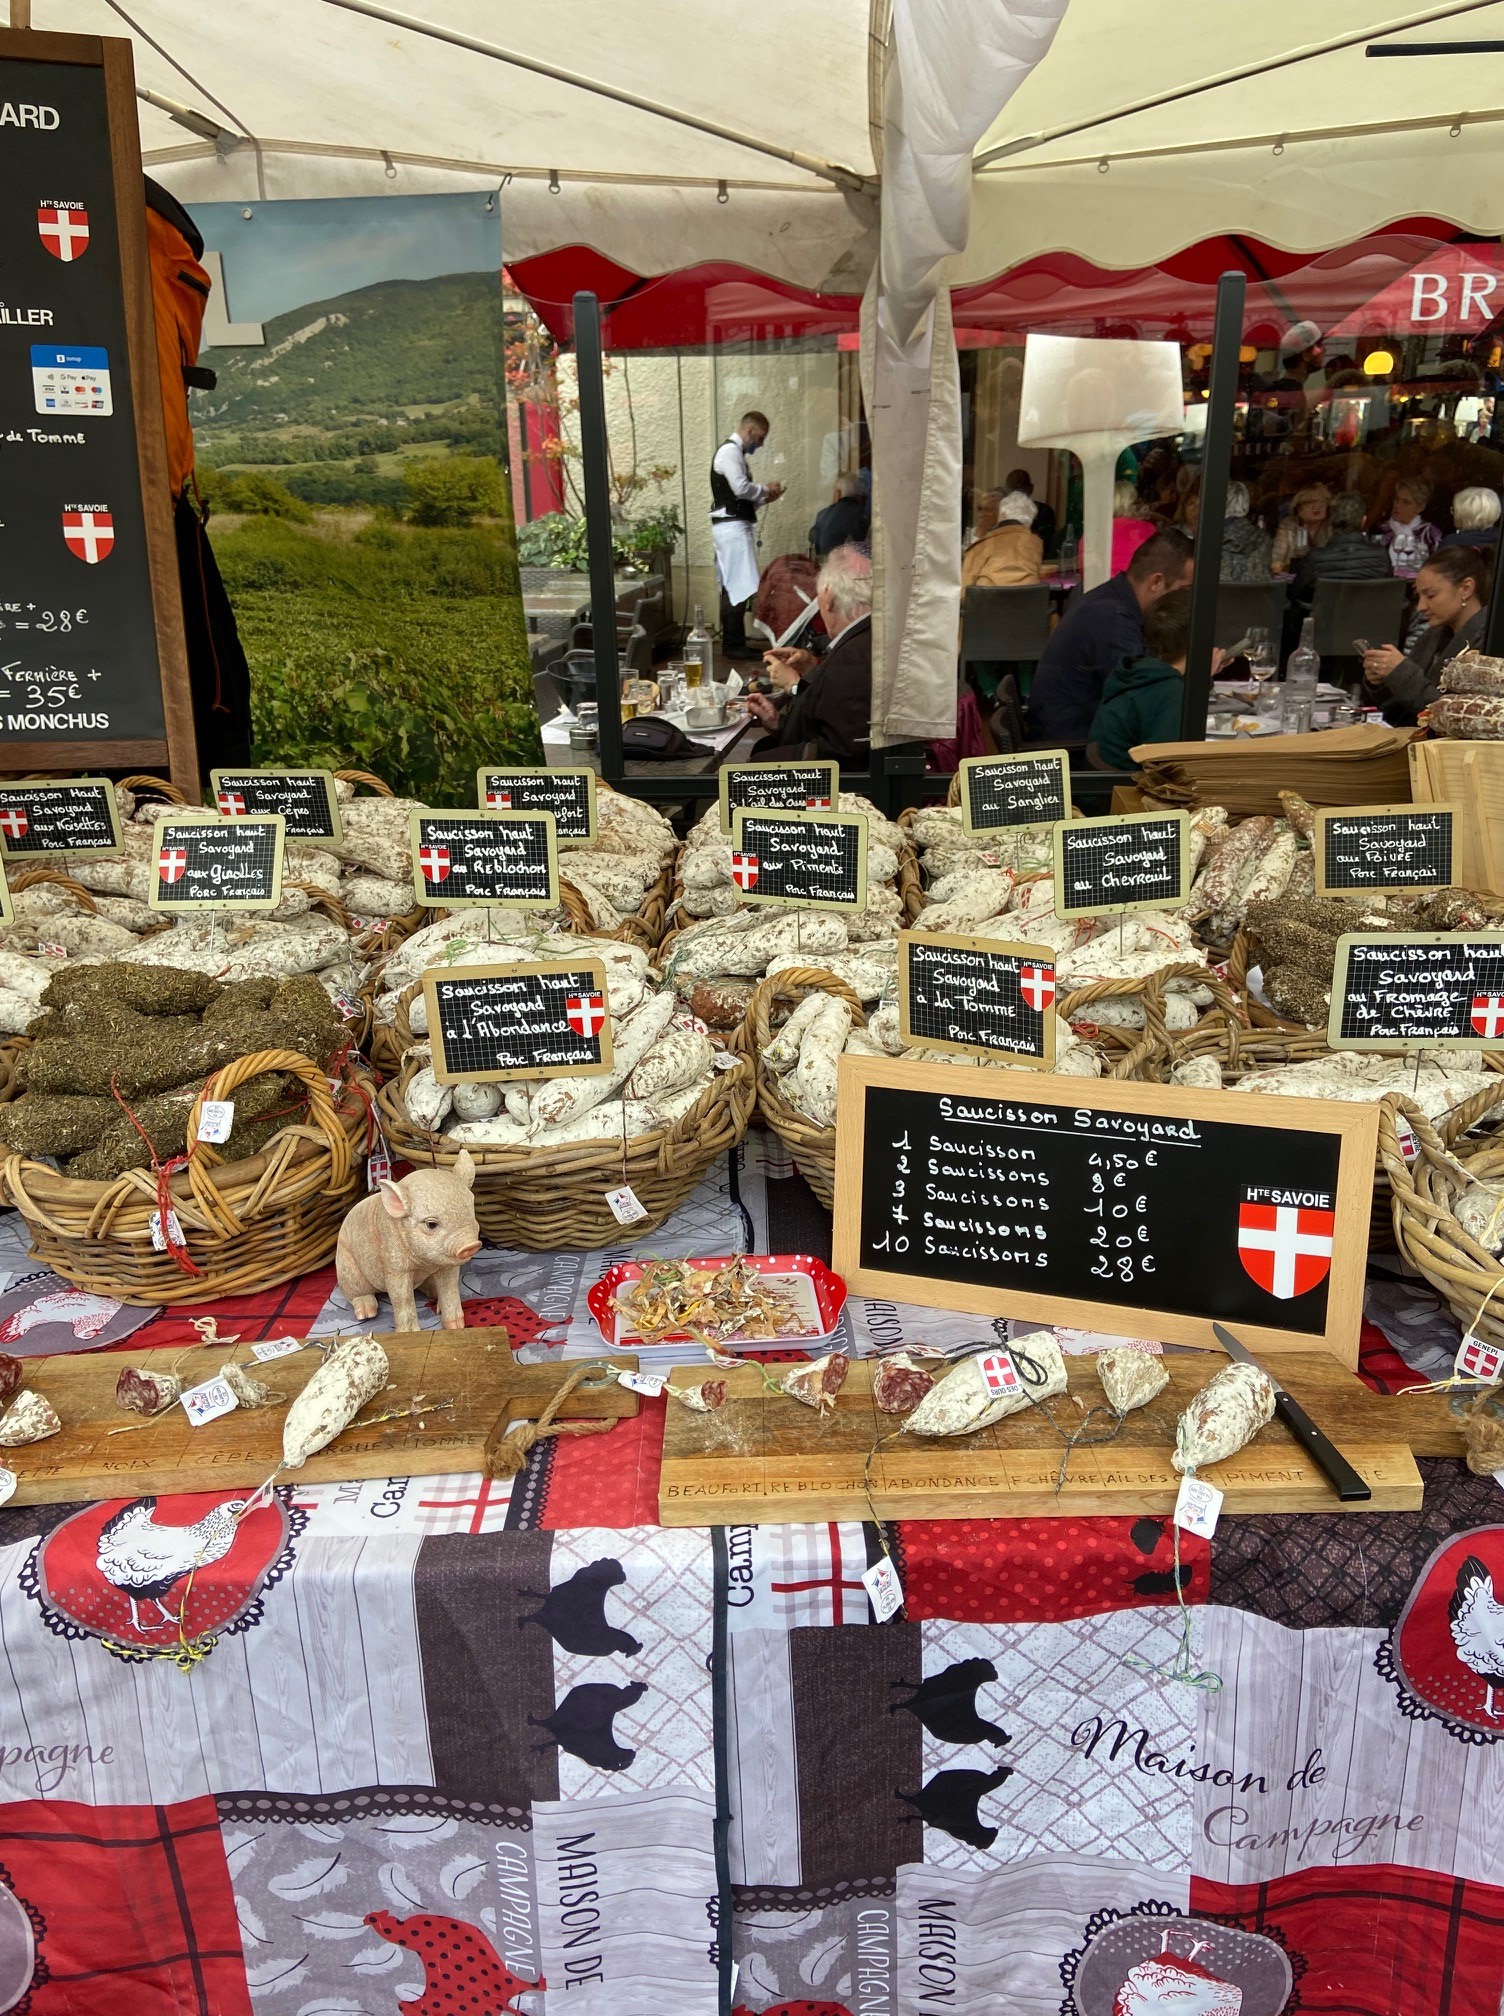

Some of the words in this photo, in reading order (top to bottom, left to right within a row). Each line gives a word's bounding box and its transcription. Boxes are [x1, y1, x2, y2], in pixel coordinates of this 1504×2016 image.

[53, 200, 84, 210] SAVOIE
[1409, 273, 1497, 321] BR
[0, 308, 54, 326] ILLER
[6, 430, 24, 442] de
[77, 504, 109, 512] SAVOIE
[7, 713, 110, 731] MONCHUS
[733, 771, 787, 782] Saucisson
[792, 769, 822, 780] haut
[974, 764, 1029, 779] Saucisson
[1033, 757, 1061, 771] haut
[221, 777, 280, 787] Saucisson
[286, 776, 317, 787] haut
[491, 775, 544, 787] Saucisson
[552, 774, 581, 785] haut
[993, 773, 1051, 792] Savoyard
[0, 790, 62, 803] Saucisson
[256, 789, 312, 803] Savoyard
[521, 789, 576, 804] Savoyard
[748, 783, 807, 799] Savoyard
[33, 802, 94, 817] Savoyard
[982, 803, 1000, 811] au
[1007, 792, 1060, 810] Sanglier
[34, 824, 55, 832] aux
[166, 828, 228, 840] Saucisson
[236, 825, 266, 837] haut
[426, 825, 493, 841] Saucisson
[500, 822, 534, 841] haut
[747, 820, 806, 835] Saucisson
[814, 823, 846, 838] haut
[1332, 821, 1396, 834] Saucisson
[1408, 815, 1441, 831] haut
[41, 839, 66, 849] Porc
[1067, 834, 1132, 850] Saucisson
[1141, 823, 1177, 842] haut
[1358, 833, 1426, 852] Savoyard
[199, 840, 255, 859] Savoyard
[465, 841, 526, 860] Savoyard
[770, 837, 844, 859] Savoyard
[1103, 846, 1167, 868] Savoyard
[187, 868, 209, 879] aux
[452, 865, 467, 874] au
[762, 861, 784, 871] aux
[790, 859, 844, 875] Piments
[1350, 868, 1376, 878] Porc
[465, 884, 492, 898] Porc
[785, 884, 807, 896] Porc
[1074, 880, 1093, 890] au
[913, 947, 984, 967] Saucisson
[987, 953, 1020, 974] haut
[1354, 946, 1450, 961] Saucisson
[1031, 962, 1054, 971] SAVOIE
[1378, 962, 1475, 989] Savoyard
[441, 980, 527, 999] Saucisson
[537, 974, 580, 990] haut
[932, 969, 1000, 996] Savoyard
[577, 991, 601, 999] SAVOIE
[917, 988, 927, 1004] à
[1348, 992, 1367, 1003] au
[470, 994, 545, 1018] Savoyard
[1356, 1004, 1380, 1019] de
[949, 1024, 976, 1041] Porc
[1370, 1024, 1398, 1036] Porc
[496, 1053, 529, 1067] Porc
[939, 1097, 1058, 1124] Saucisson
[1074, 1109, 1202, 1142] Savoyard
[892, 1130, 912, 1150] 1
[929, 1135, 1036, 1160] Saucisson
[896, 1155, 911, 1174] 2
[928, 1158, 1050, 1186] Saucissons
[892, 1179, 905, 1198] 3
[925, 1183, 1050, 1211] Saucissons
[1271, 1190, 1330, 1208] SAVOIE
[923, 1211, 1047, 1240] Saucissons
[872, 1230, 910, 1252] 10
[924, 1235, 1049, 1267] Saucissons
[539, 1255, 580, 1319] CAMPAGNE
[888, 1477, 1000, 1488] ABONDANCE
[1138, 1471, 1168, 1483] DES
[1071, 1716, 1268, 1794] Maison
[1287, 1748, 1326, 1791] de
[1204, 1805, 1425, 1862] Campagne
[556, 1832, 602, 1949] MAISON
[495, 1841, 536, 1976] CAMPAGNE
[918, 1899, 956, 2006] MAISON
[564, 1954, 604, 1991] DE
